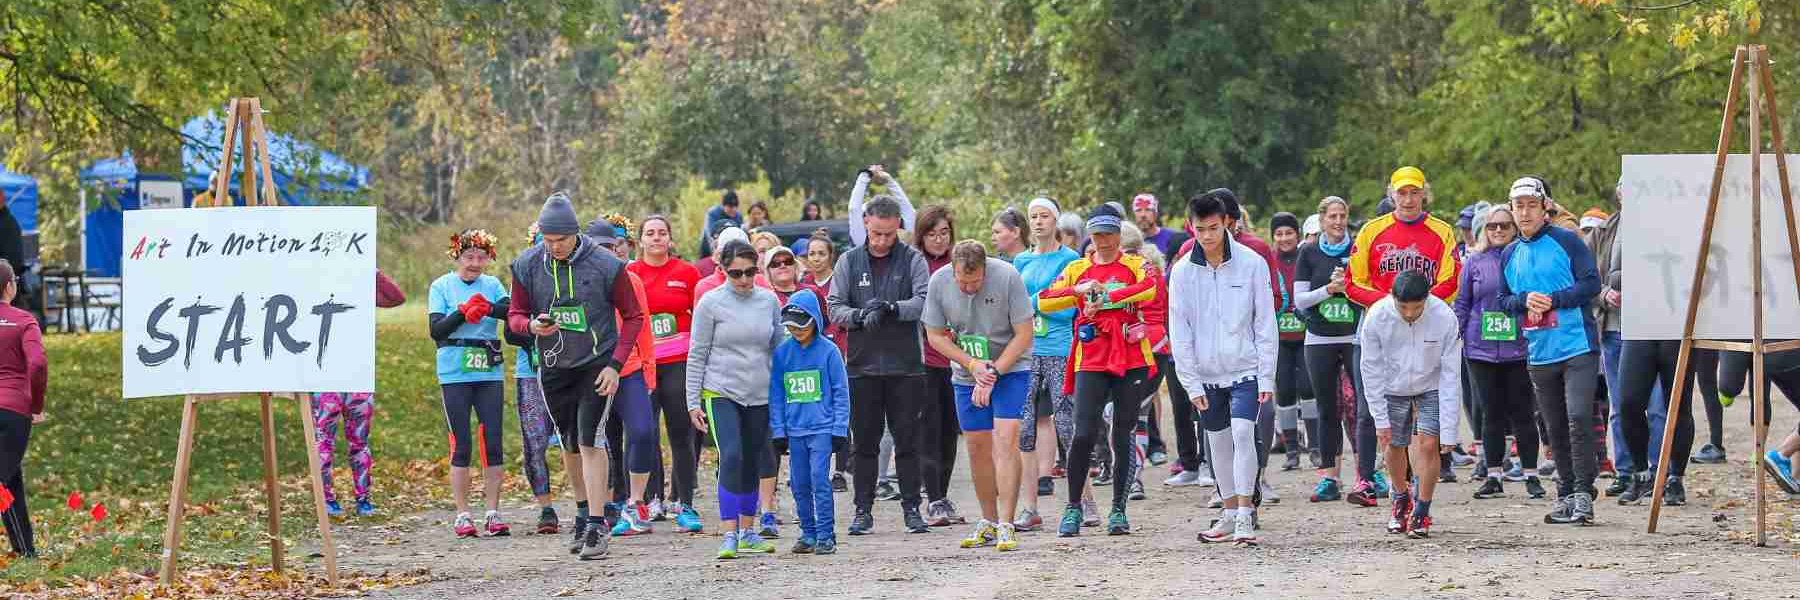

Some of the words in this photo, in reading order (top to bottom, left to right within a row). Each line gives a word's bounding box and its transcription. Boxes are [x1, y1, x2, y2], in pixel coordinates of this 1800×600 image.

[130, 236, 172, 260] Art
[186, 232, 214, 259] In
[221, 232, 306, 257] Motion
[552, 311, 580, 325] 260
[1324, 303, 1349, 318] 214
[136, 292, 356, 371] START
[652, 319, 671, 335] 68
[1487, 317, 1511, 332] 254
[788, 376, 815, 394] 250
